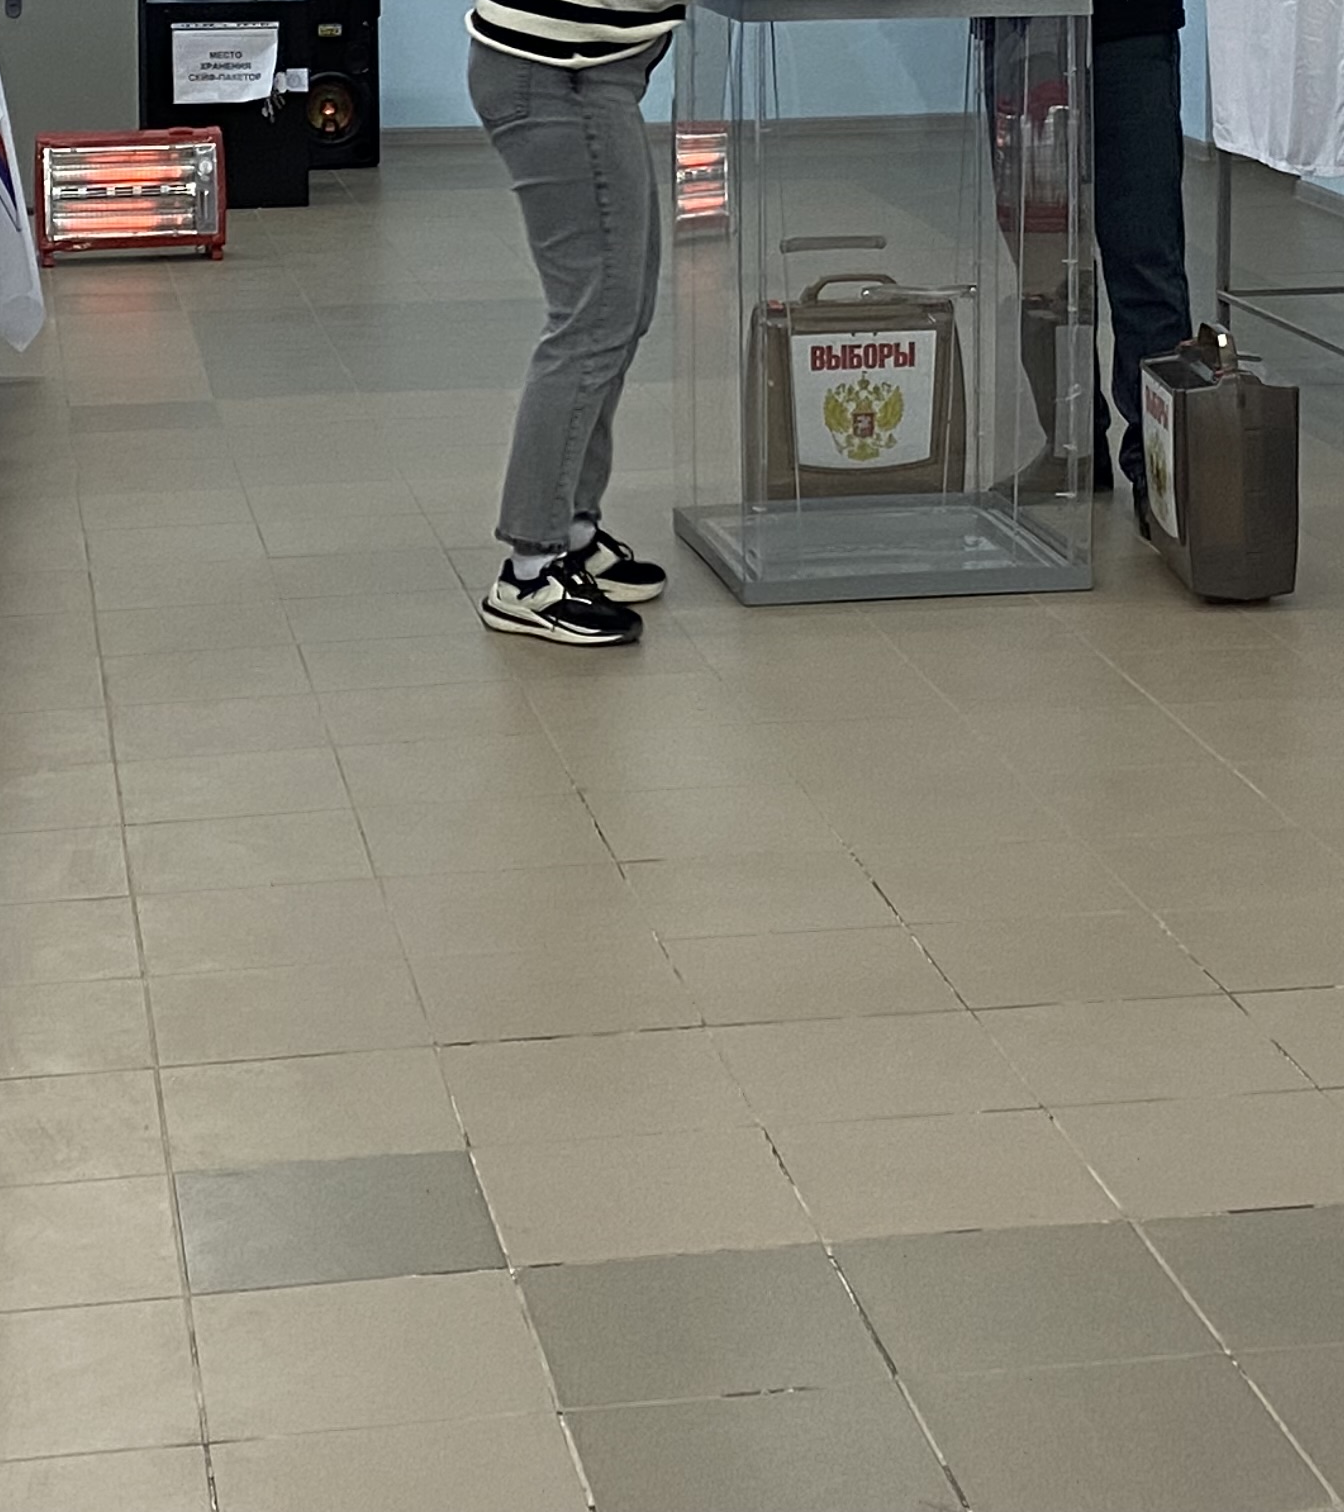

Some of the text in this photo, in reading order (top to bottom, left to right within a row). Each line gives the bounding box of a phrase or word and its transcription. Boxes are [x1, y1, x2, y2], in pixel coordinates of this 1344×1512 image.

[209, 51, 243, 59] МЕСТО
[200, 61, 252, 70] ХРАНЕНИЯ
[810, 342, 916, 371] ВЫБОРЫ
